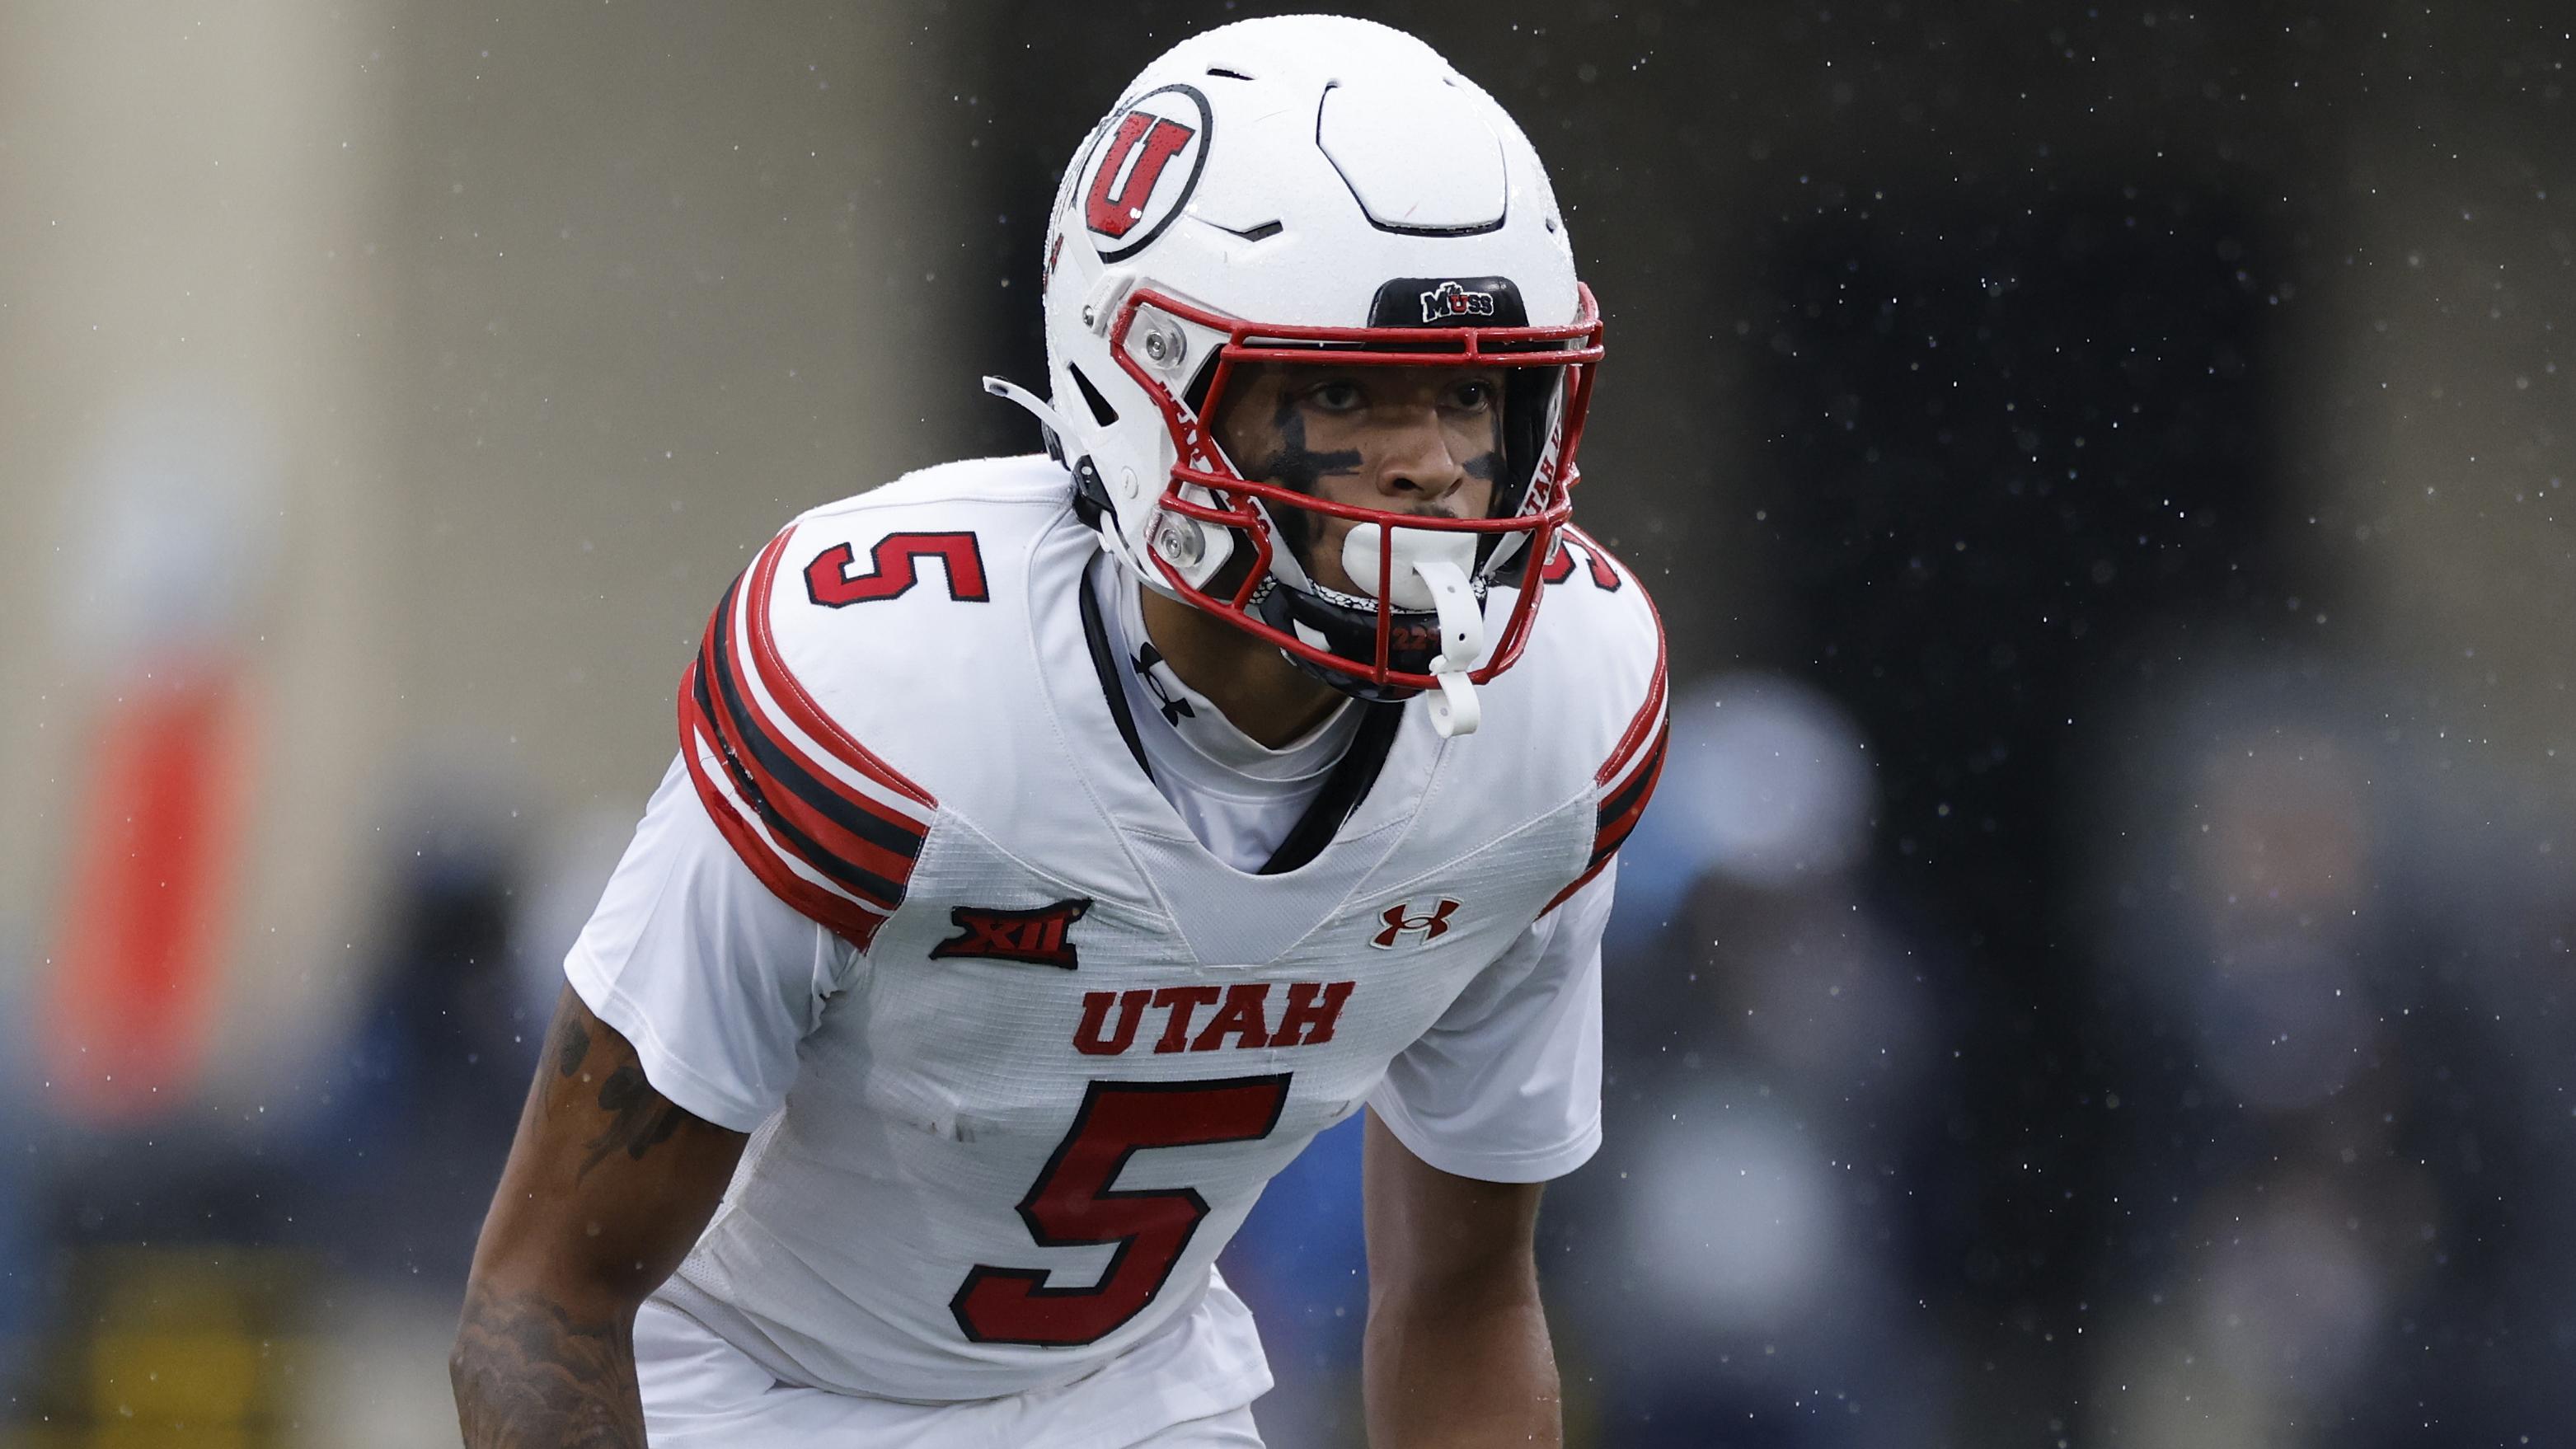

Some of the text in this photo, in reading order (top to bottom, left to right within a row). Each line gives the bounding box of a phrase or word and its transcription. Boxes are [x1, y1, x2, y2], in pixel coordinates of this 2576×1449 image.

[1085, 110, 1196, 240] U
[804, 531, 989, 609] 5
[929, 898, 1093, 970] XII
[1072, 981, 1356, 1056] UTAH
[949, 1072, 1293, 1346] 5
